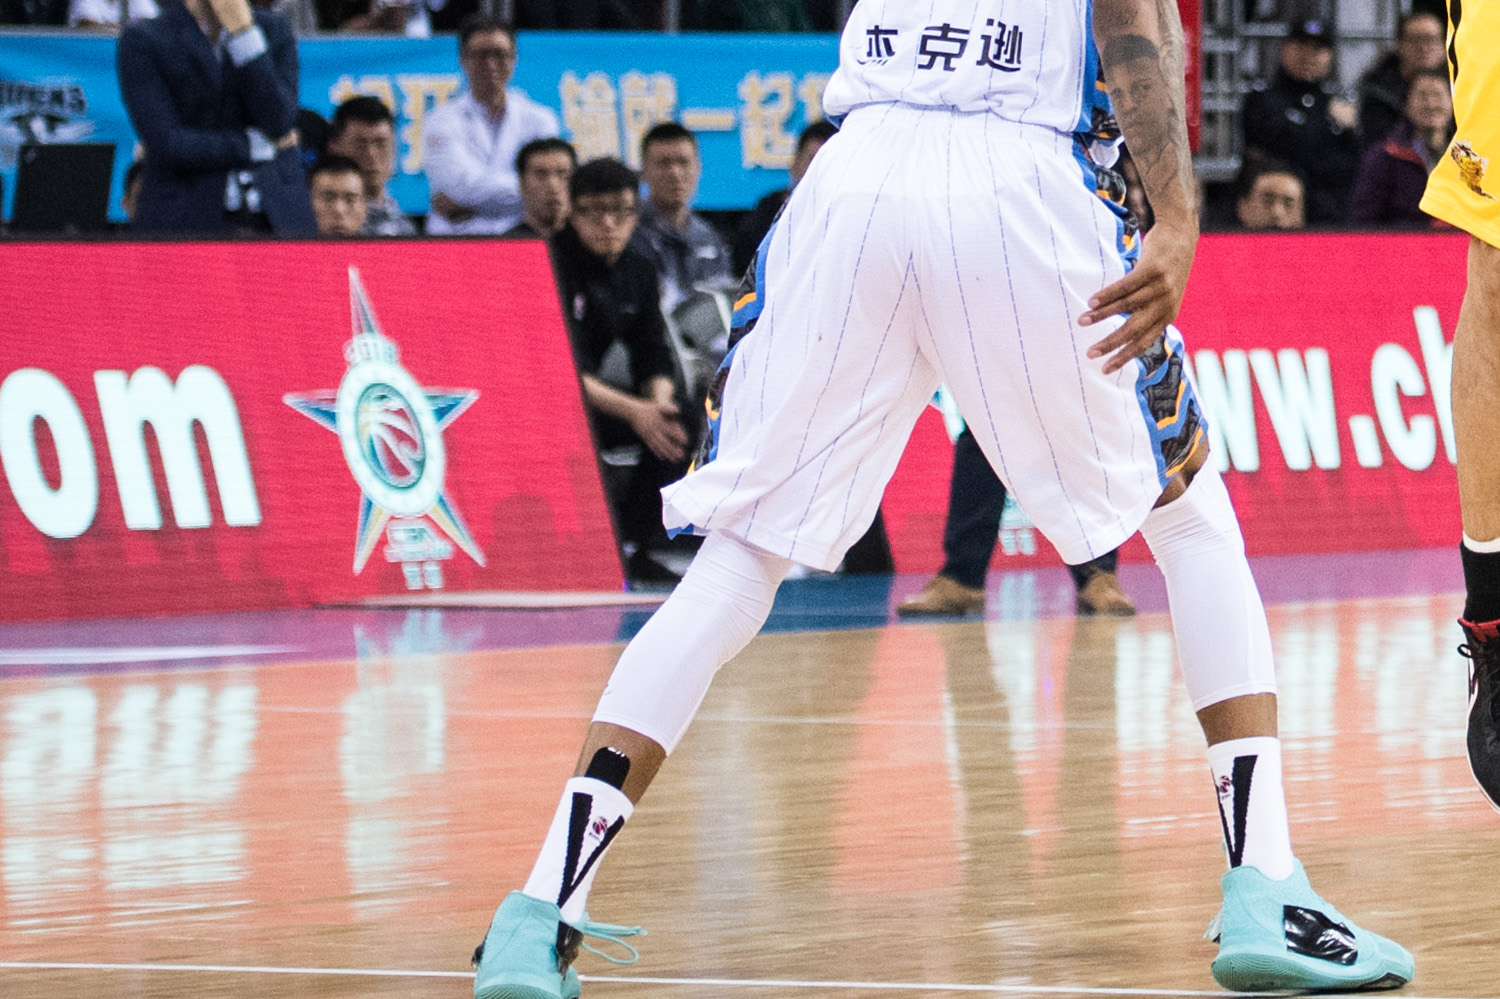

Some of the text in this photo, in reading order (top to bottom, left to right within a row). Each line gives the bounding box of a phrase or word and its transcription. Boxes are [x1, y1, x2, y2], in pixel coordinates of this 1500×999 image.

[857, 17, 1023, 72] 杰克逊
[0, 363, 262, 539] om
